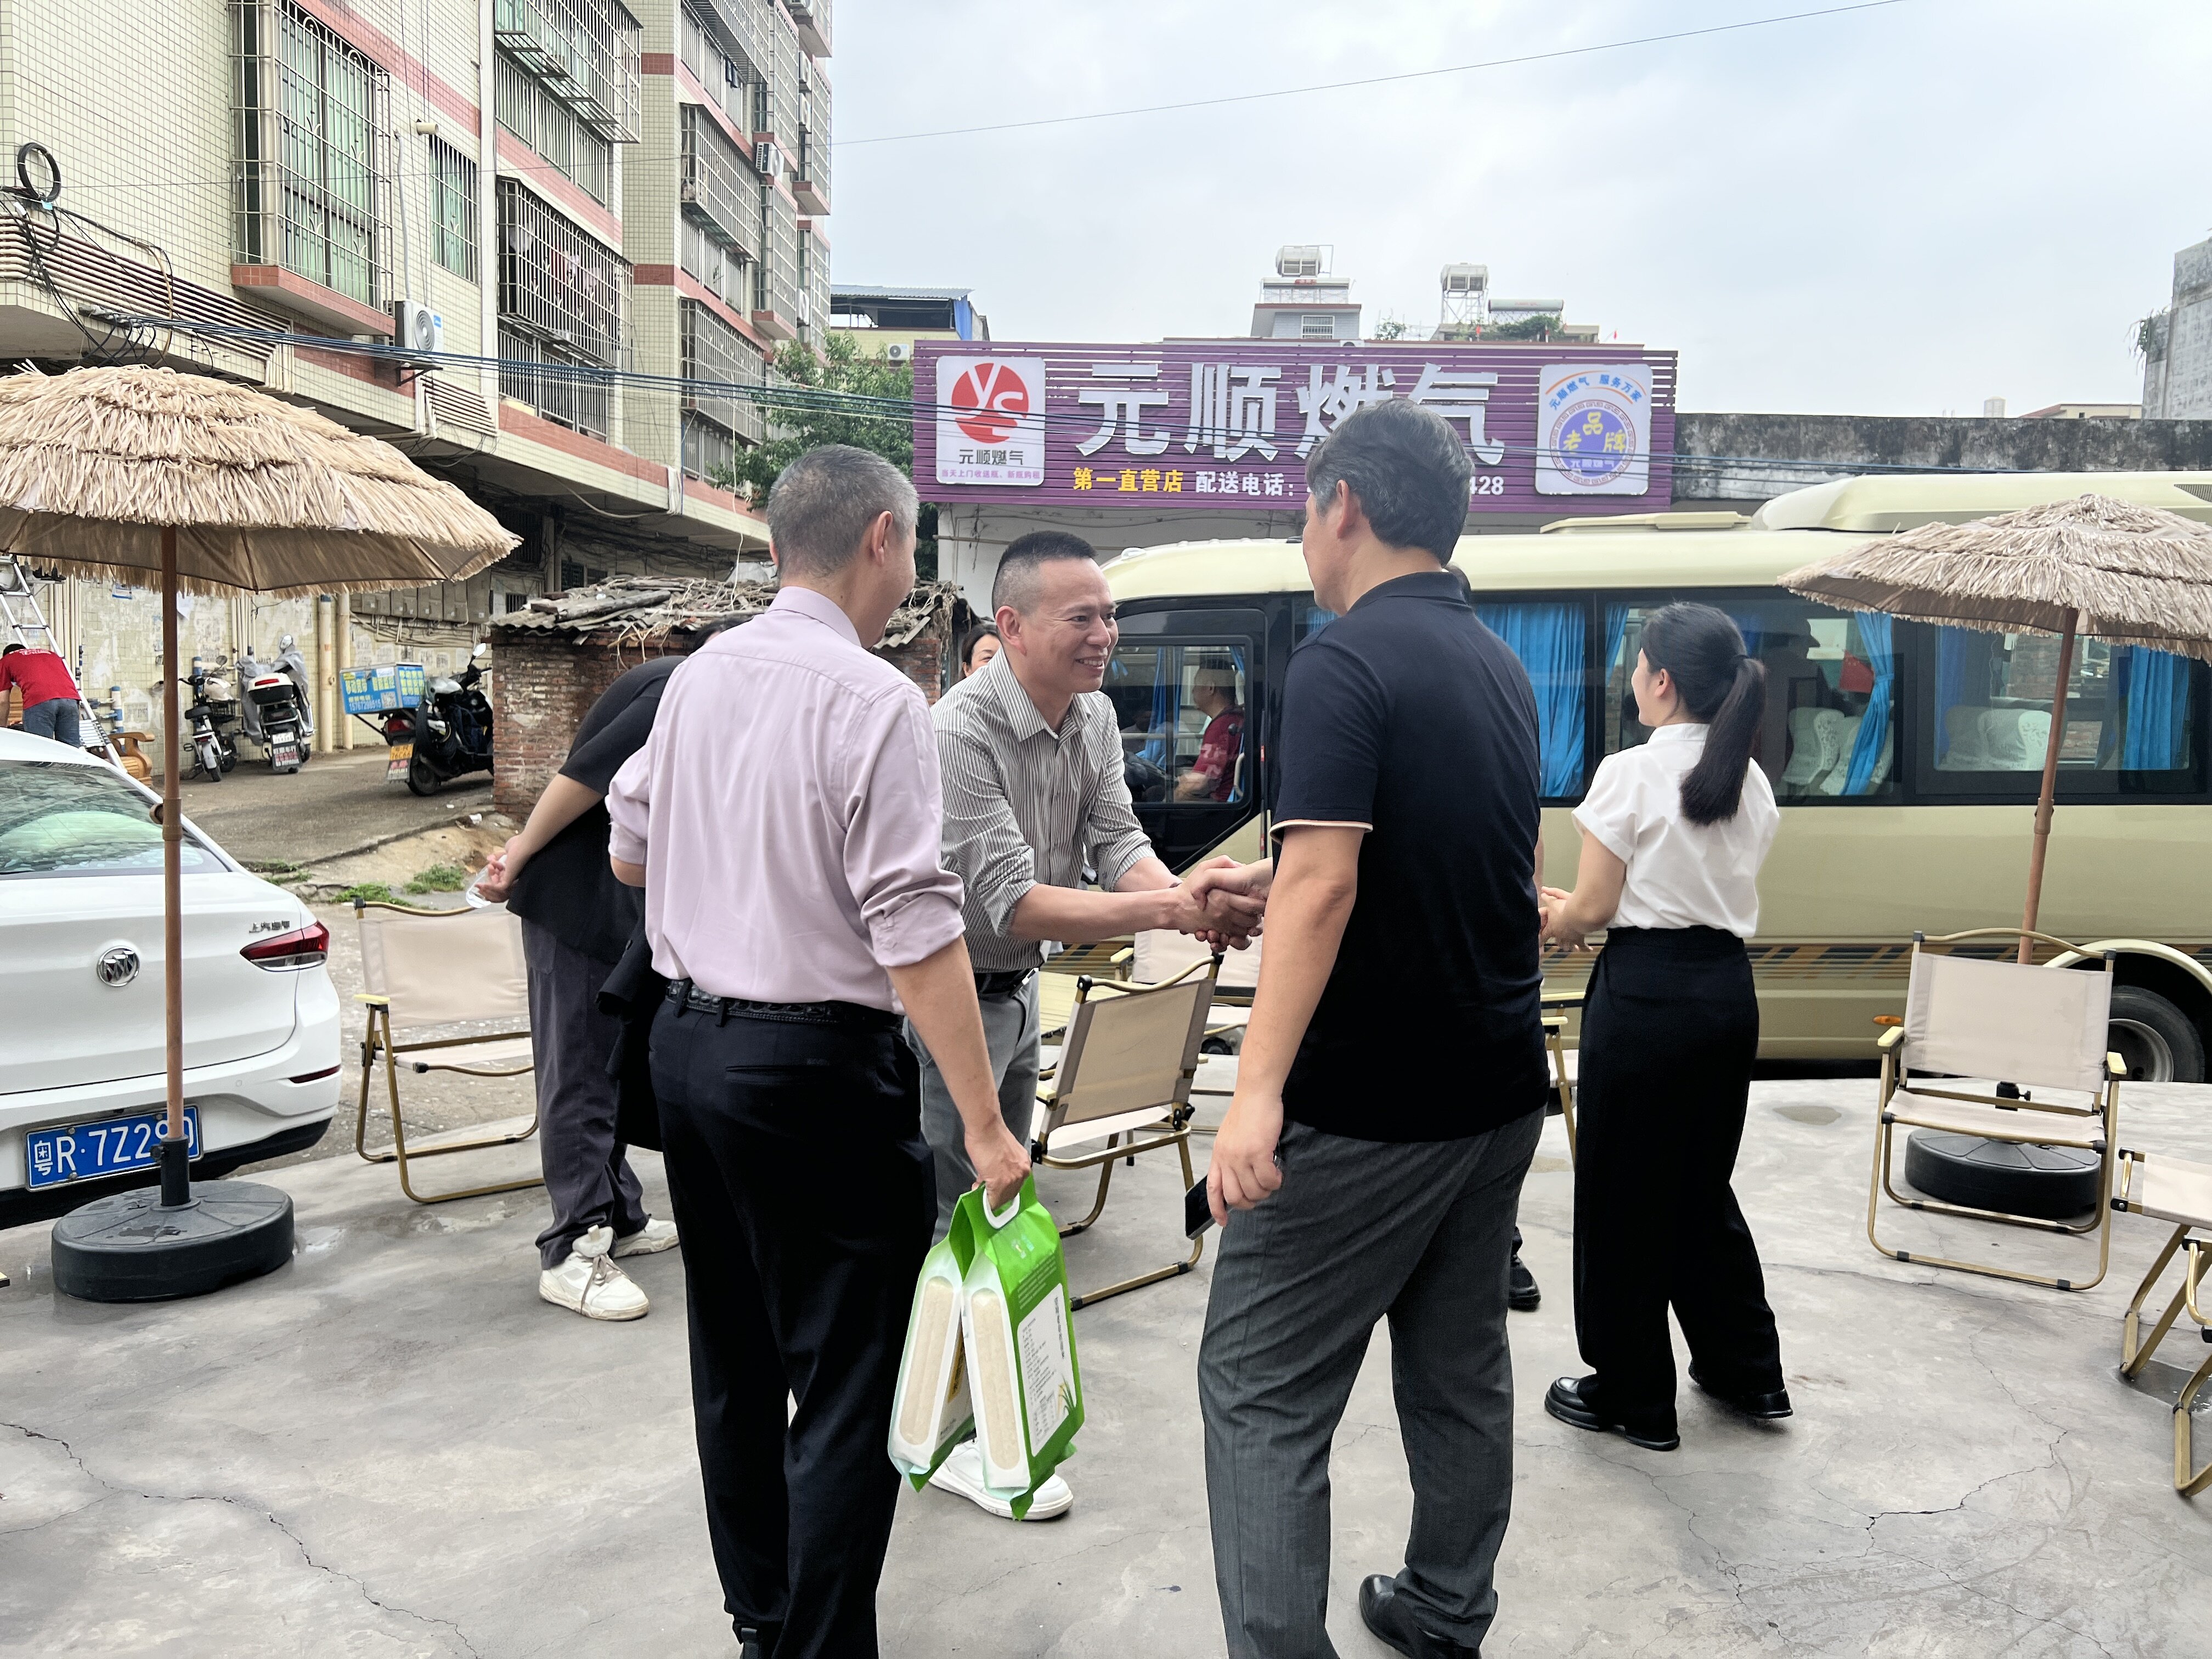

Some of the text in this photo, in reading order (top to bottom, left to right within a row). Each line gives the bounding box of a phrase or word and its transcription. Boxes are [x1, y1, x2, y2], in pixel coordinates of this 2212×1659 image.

[1549, 374, 1643, 410] 元顺燃气 服务万家
[1076, 362, 1505, 465] 元顺燃气
[959, 449, 1023, 465] 元顺燃气
[1073, 467, 1184, 493] 第一直营店
